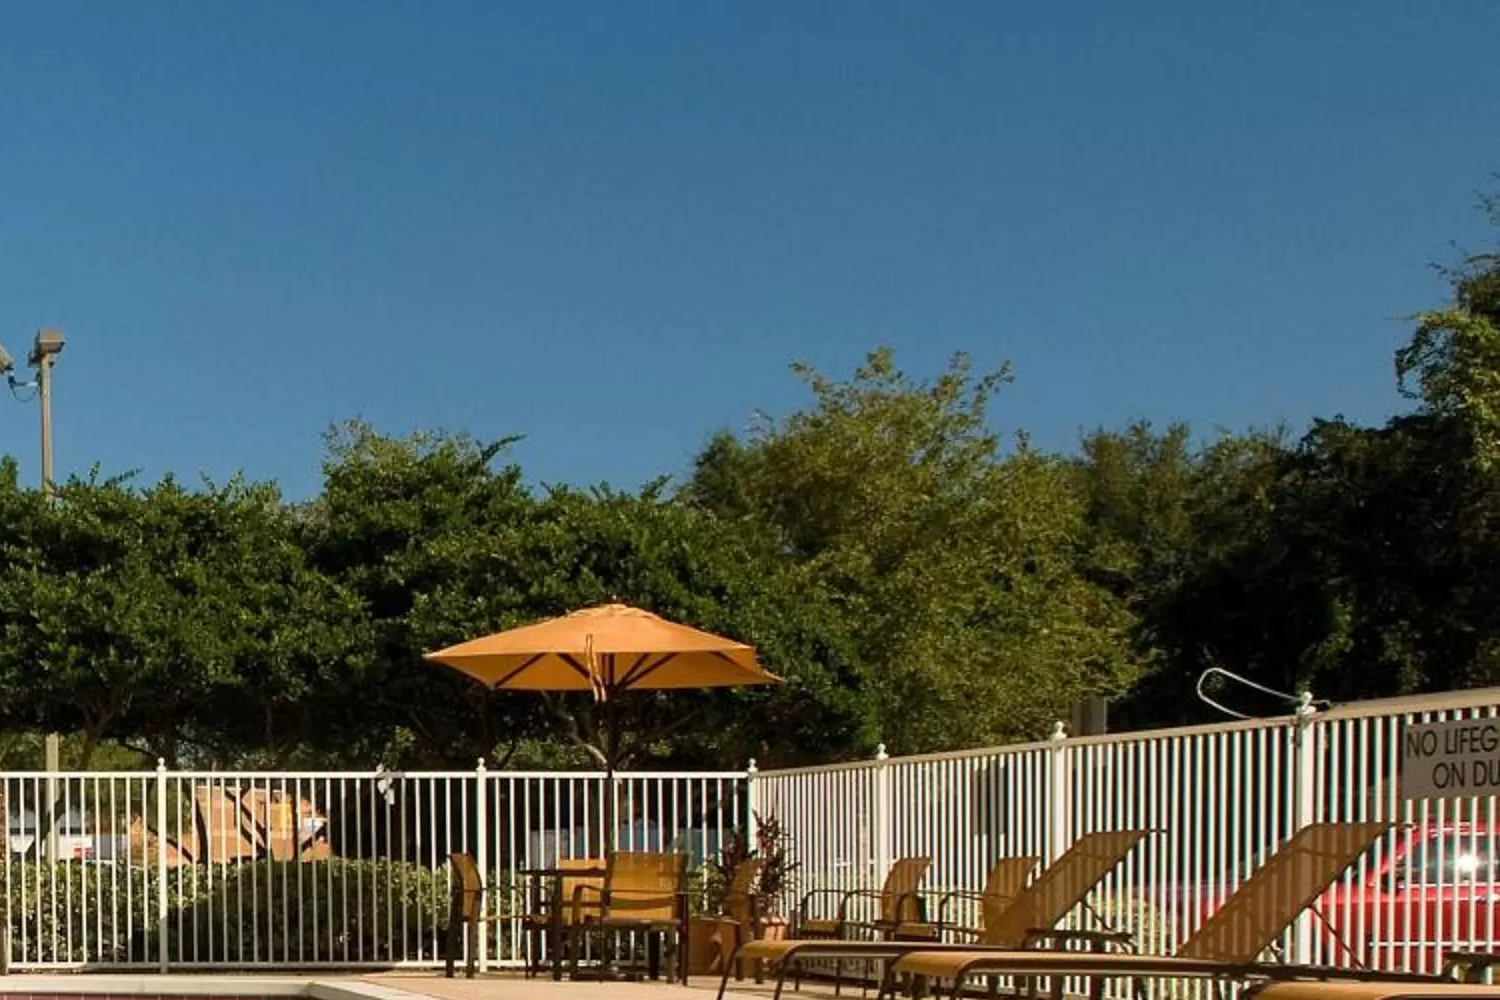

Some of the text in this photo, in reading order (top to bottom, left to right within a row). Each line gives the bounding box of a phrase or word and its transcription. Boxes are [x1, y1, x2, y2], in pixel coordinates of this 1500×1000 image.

[1407, 725, 1499, 758] NO LIFEG
[1432, 758, 1500, 789] ON DU
